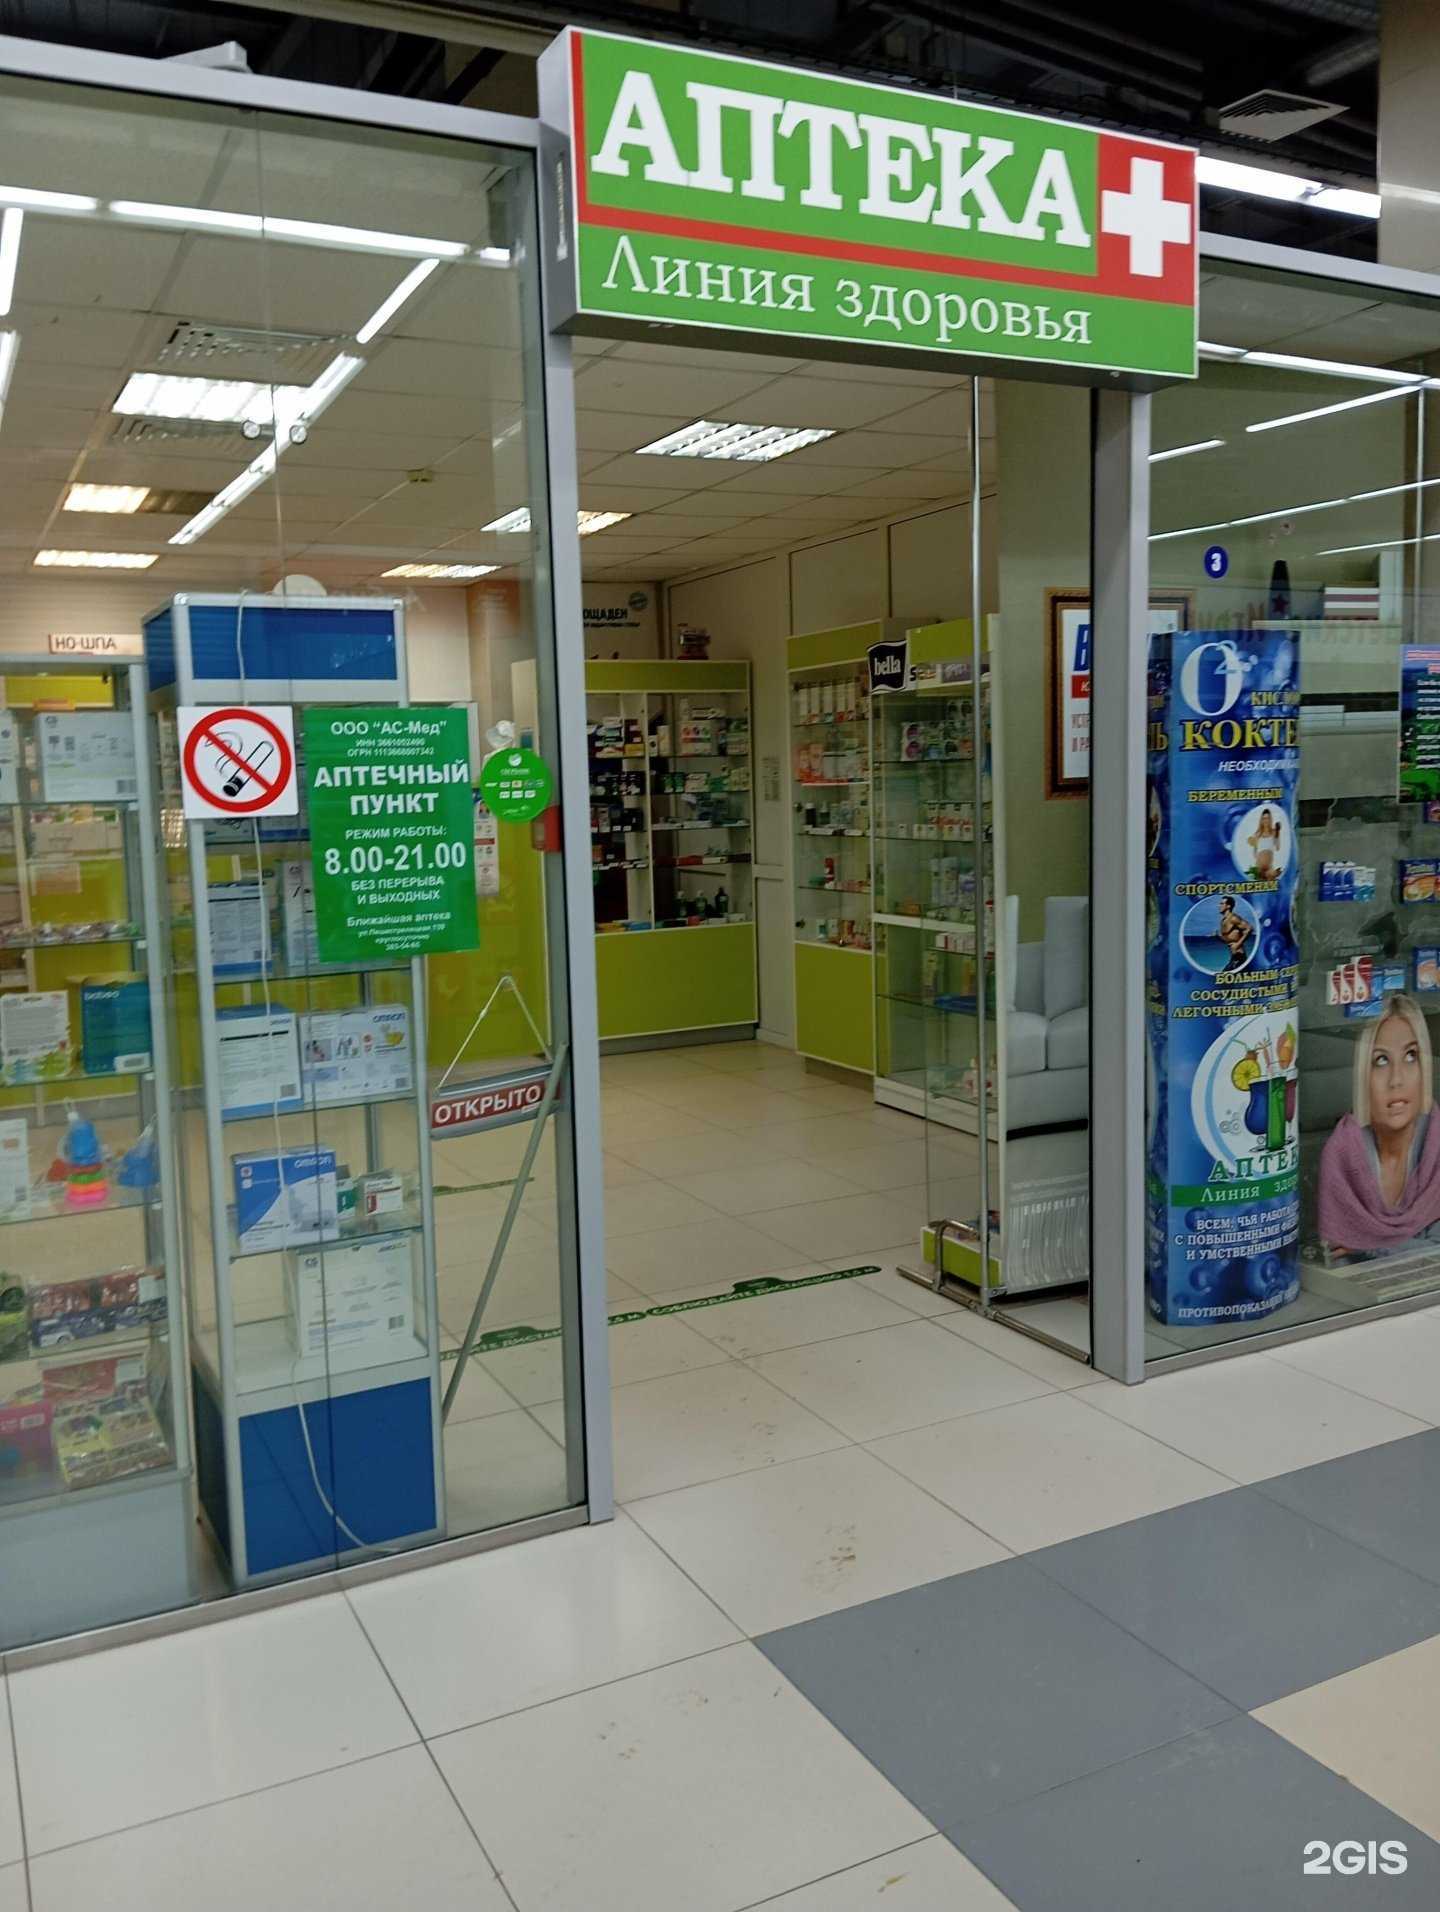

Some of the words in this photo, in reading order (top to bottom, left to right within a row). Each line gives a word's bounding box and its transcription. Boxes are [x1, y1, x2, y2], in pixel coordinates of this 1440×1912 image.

[591, 70, 1091, 248] АПТЕКА
[602, 235, 814, 313] Линия
[836, 277, 1092, 344] здоровья
[1210, 552, 1222, 572] 3
[55, 636, 117, 650] НО-ШПА
[874, 654, 901, 676] bella
[330, 721, 369, 735] ООО
[347, 749, 372, 757] ОГРН
[314, 759, 469, 787] АПТЕЧНЫЙ
[350, 793, 439, 816] ПУНКТ
[345, 828, 390, 840] РЕЖИМ
[393, 825, 447, 838] РАБОТЫ:
[325, 842, 467, 875] 8.00-21.00
[351, 879, 376, 891] БЕЗ
[378, 876, 445, 889] ПЕРЕРЫВА
[357, 895, 366, 905] И
[369, 889, 441, 904] ВЫХОДНЫХ
[347, 913, 412, 928] Ближайшая
[415, 911, 452, 922] аптека
[1215, 968, 1279, 985] БОЛЬНЫМ
[434, 1085, 541, 1123] ОТКРЫТО
[1200, 1185, 1260, 1203] Линия
[1237, 1214, 1258, 1227] ЧЬЯ
[1175, 1235, 1184, 1246] С
[1188, 1224, 1281, 1246] ПОВЫШЕННЫМИ
[1186, 1248, 1196, 1260] И
